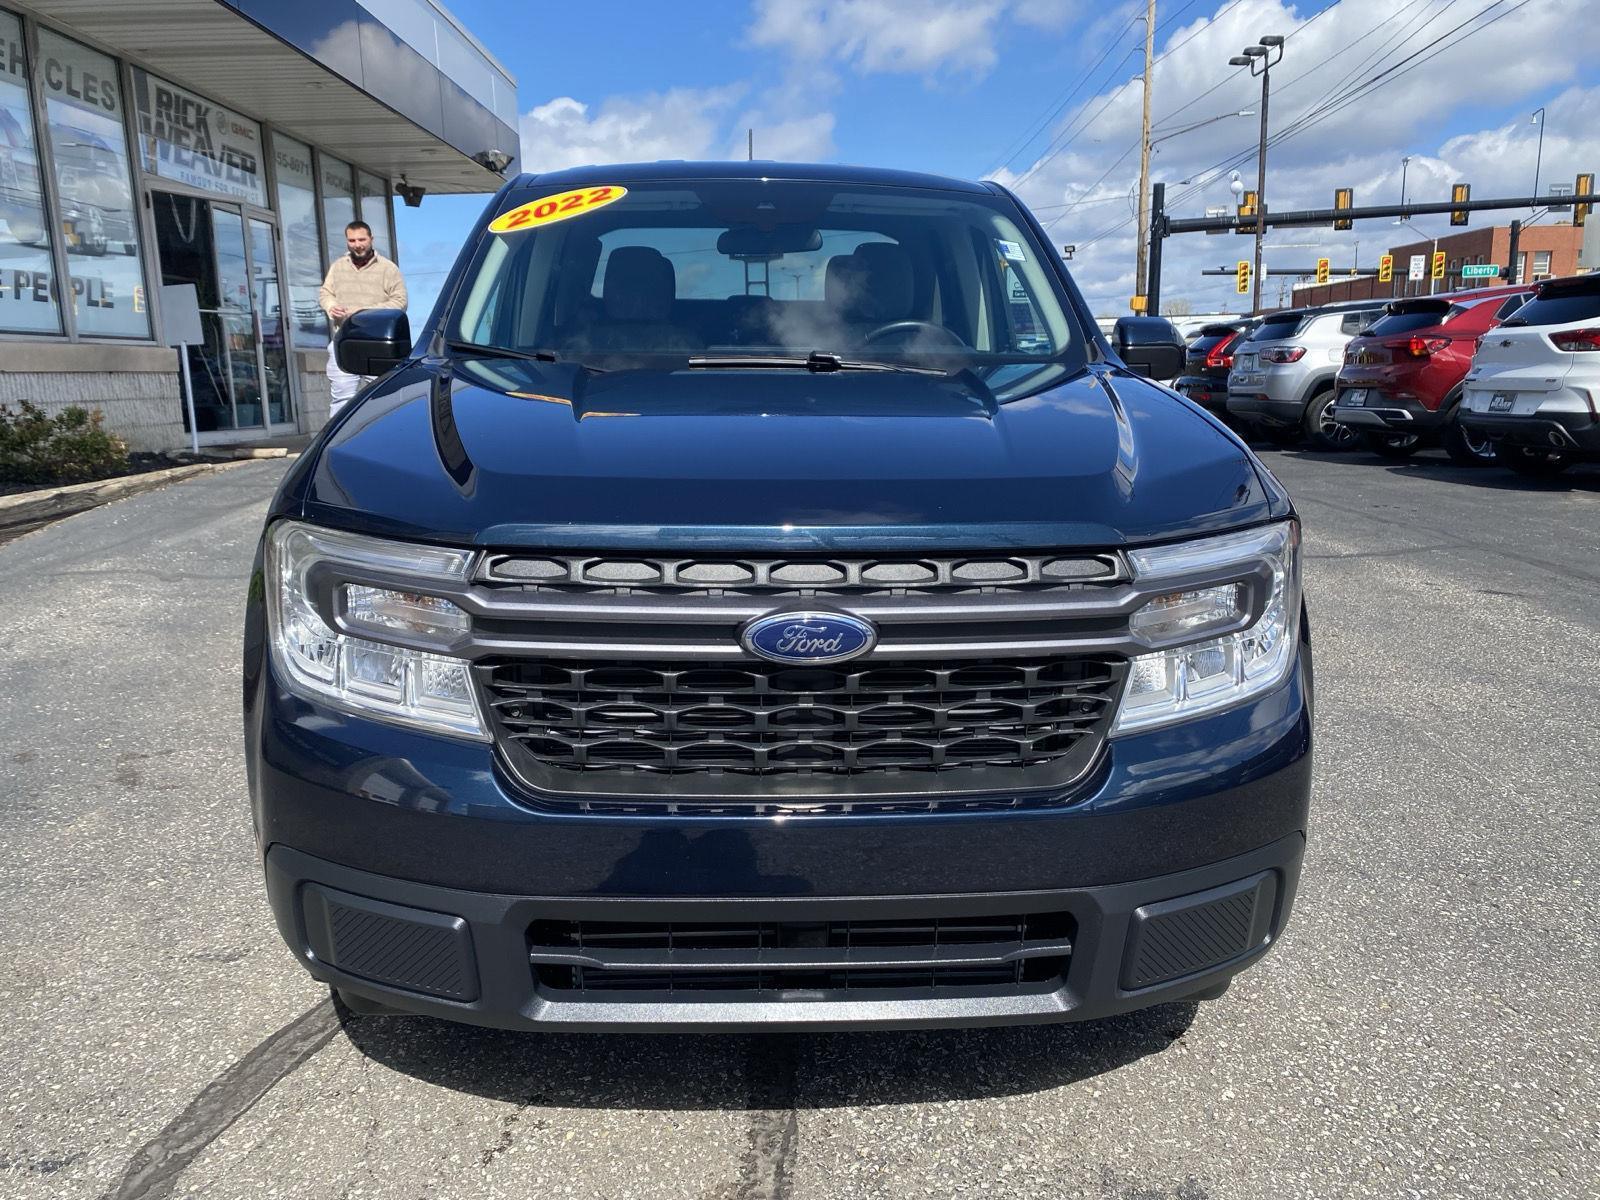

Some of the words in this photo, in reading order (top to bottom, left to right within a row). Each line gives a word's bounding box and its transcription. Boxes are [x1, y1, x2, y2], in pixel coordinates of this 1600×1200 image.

[156, 86, 211, 134] RICK
[231, 122, 255, 140] GMC
[142, 114, 257, 189] WEAVER
[506, 187, 614, 229] 2022
[1466, 267, 1495, 276] Liberty
[776, 624, 843, 653] Ford
